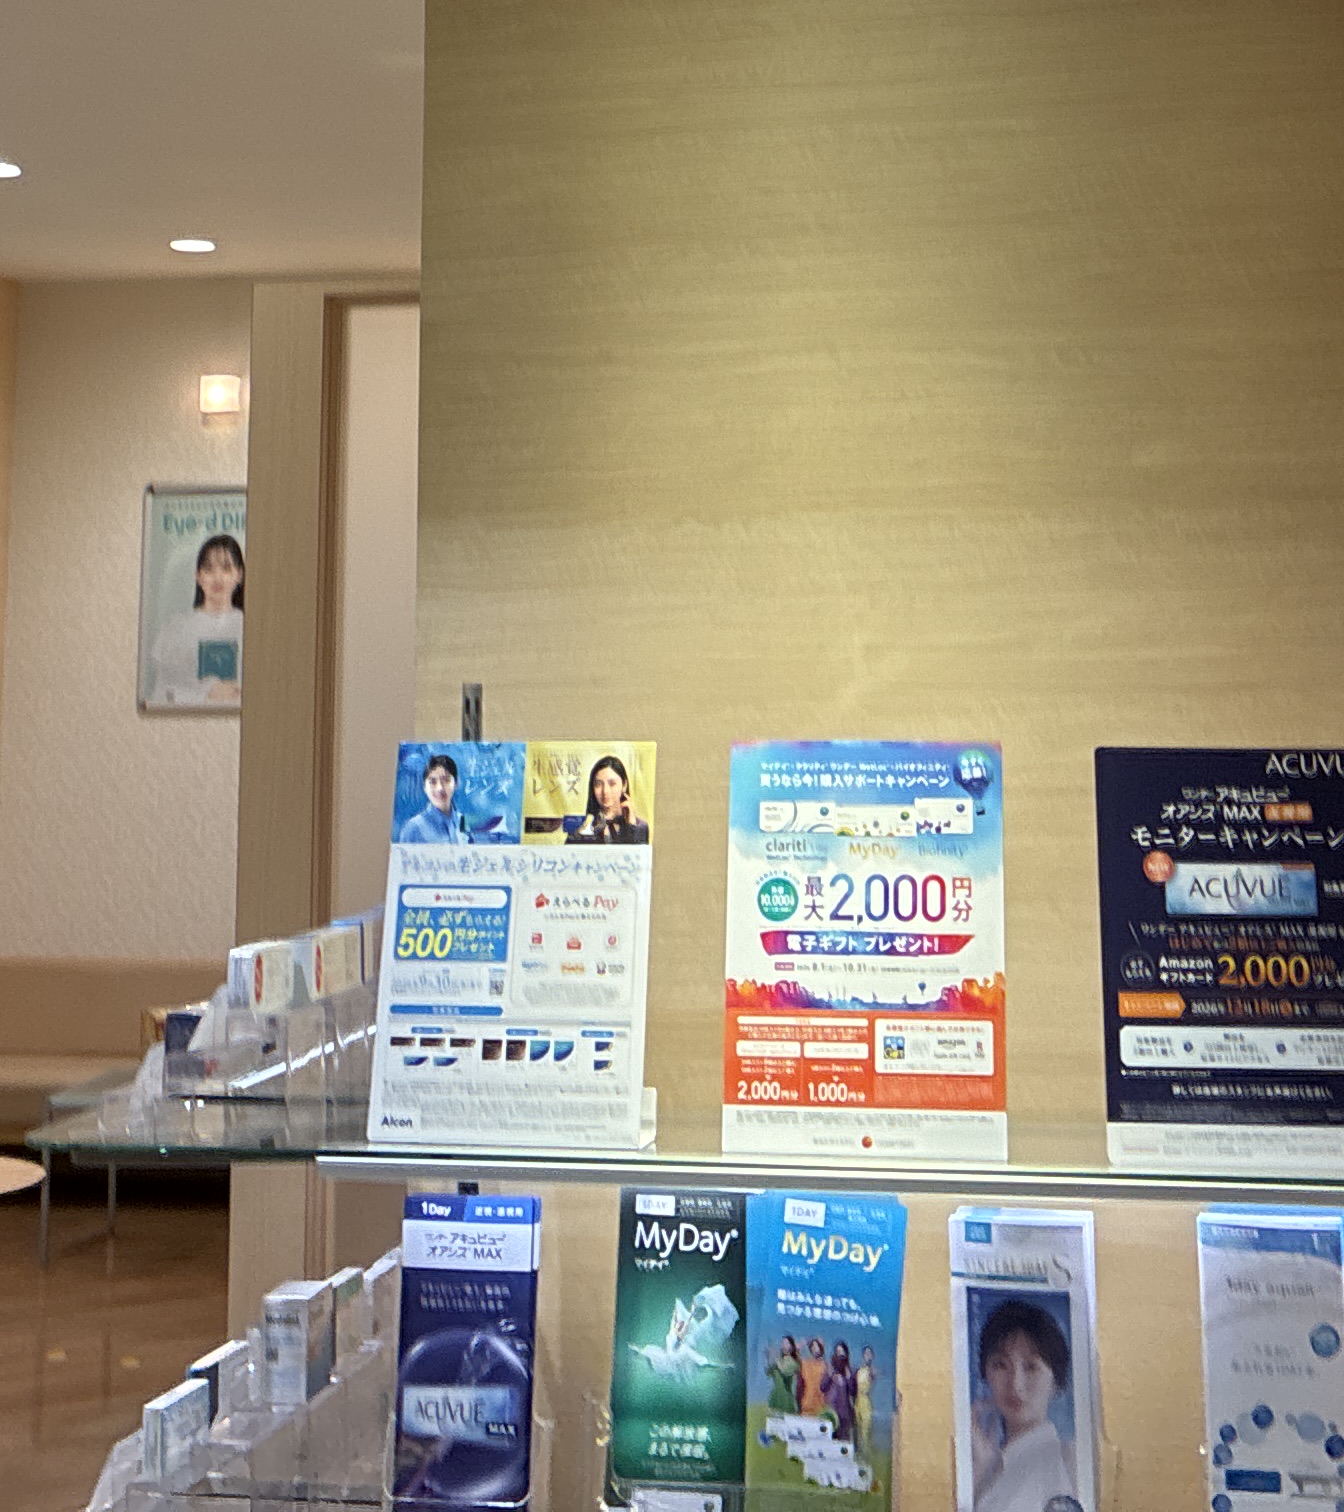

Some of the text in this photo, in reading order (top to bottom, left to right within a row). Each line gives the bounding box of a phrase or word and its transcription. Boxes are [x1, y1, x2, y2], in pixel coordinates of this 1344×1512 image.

[1222, 804, 1262, 822] MAX
[829, 873, 946, 925] 2,000
[1189, 868, 1290, 910] ACUVUE
[397, 927, 453, 958] 500
[1159, 955, 1214, 969] Amazon
[1217, 954, 1311, 988] 2,000
[381, 1116, 413, 1128] Alcon
[473, 1247, 503, 1260] MAX
[634, 1220, 731, 1262] MyDay
[781, 1229, 882, 1273] MyDay
